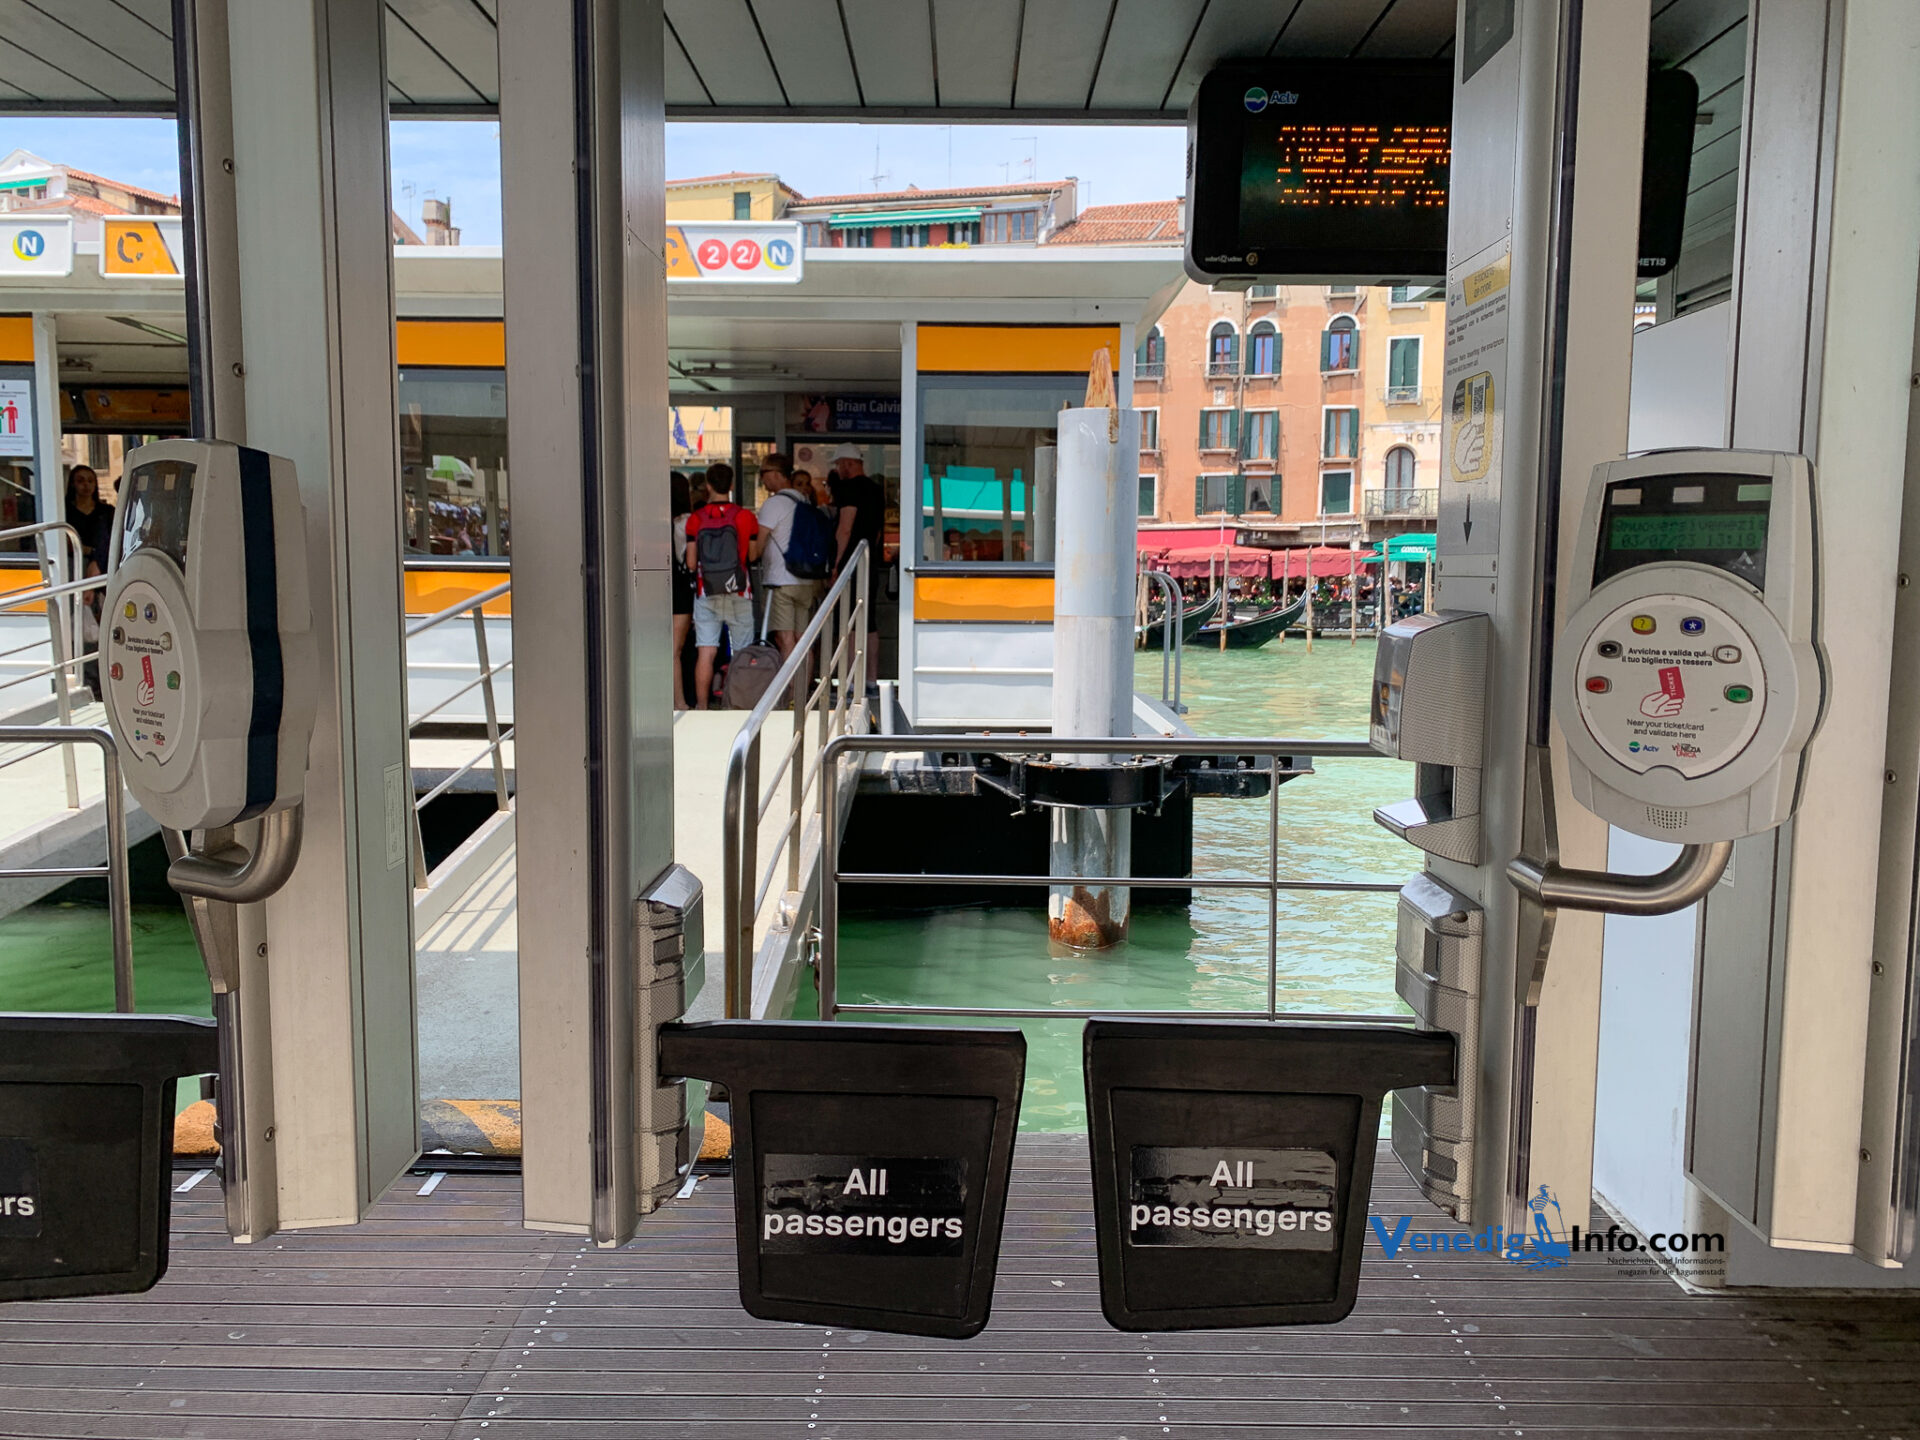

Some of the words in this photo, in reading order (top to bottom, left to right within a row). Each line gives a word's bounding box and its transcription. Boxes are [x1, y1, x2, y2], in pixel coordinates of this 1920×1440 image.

[21, 236, 37, 254] N
[706, 245, 720, 264] 2
[770, 246, 788, 264] N
[836, 399, 866, 412] Brian
[1628, 647, 1660, 656] Avvicina
[1668, 648, 1692, 657] valida
[1642, 655, 1674, 665] biglietto
[1682, 658, 1713, 666] tessera
[1667, 671, 1678, 696] TICKET
[1626, 719, 1645, 727] Near
[1645, 721, 1662, 730] your
[1663, 722, 1705, 732] ticket/card
[1633, 727, 1648, 736] and
[1649, 729, 1678, 738] validate
[1679, 730, 1697, 739] here
[1642, 744, 1659, 753] Actv
[843, 1168, 887, 1196] All
[1209, 1160, 1254, 1188] All
[0, 1196, 35, 1217] rs
[763, 1213, 964, 1244] passengers
[1131, 1204, 1333, 1237] passengers
